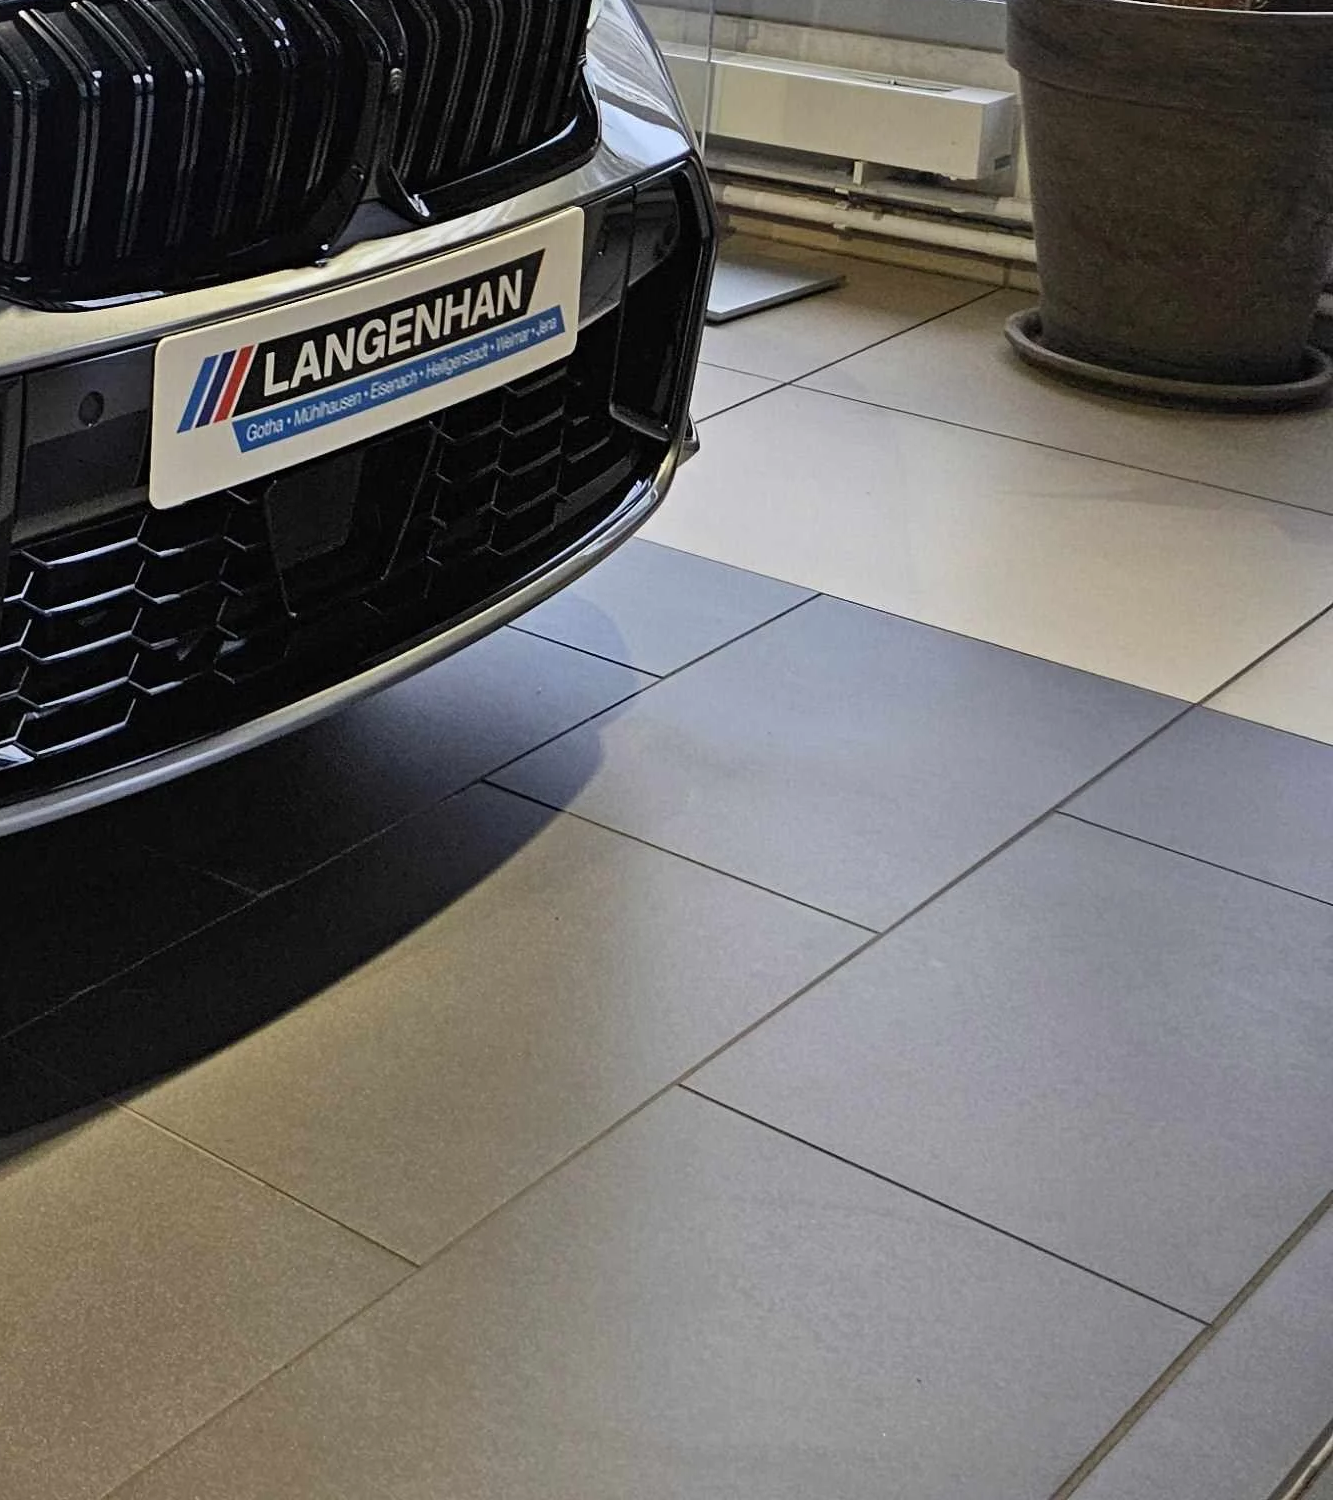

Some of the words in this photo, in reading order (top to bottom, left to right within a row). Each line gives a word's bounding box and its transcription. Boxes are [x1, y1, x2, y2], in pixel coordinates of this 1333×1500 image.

[245, 416, 284, 443] Gotha
[293, 389, 363, 427] Mühlhausen
[370, 368, 418, 400] Eisenach
[425, 343, 490, 380] Heiligenstadt
[496, 328, 531, 353] Weimar
[535, 316, 557, 338] Jena
[263, 269, 523, 397] LANGENHAN
